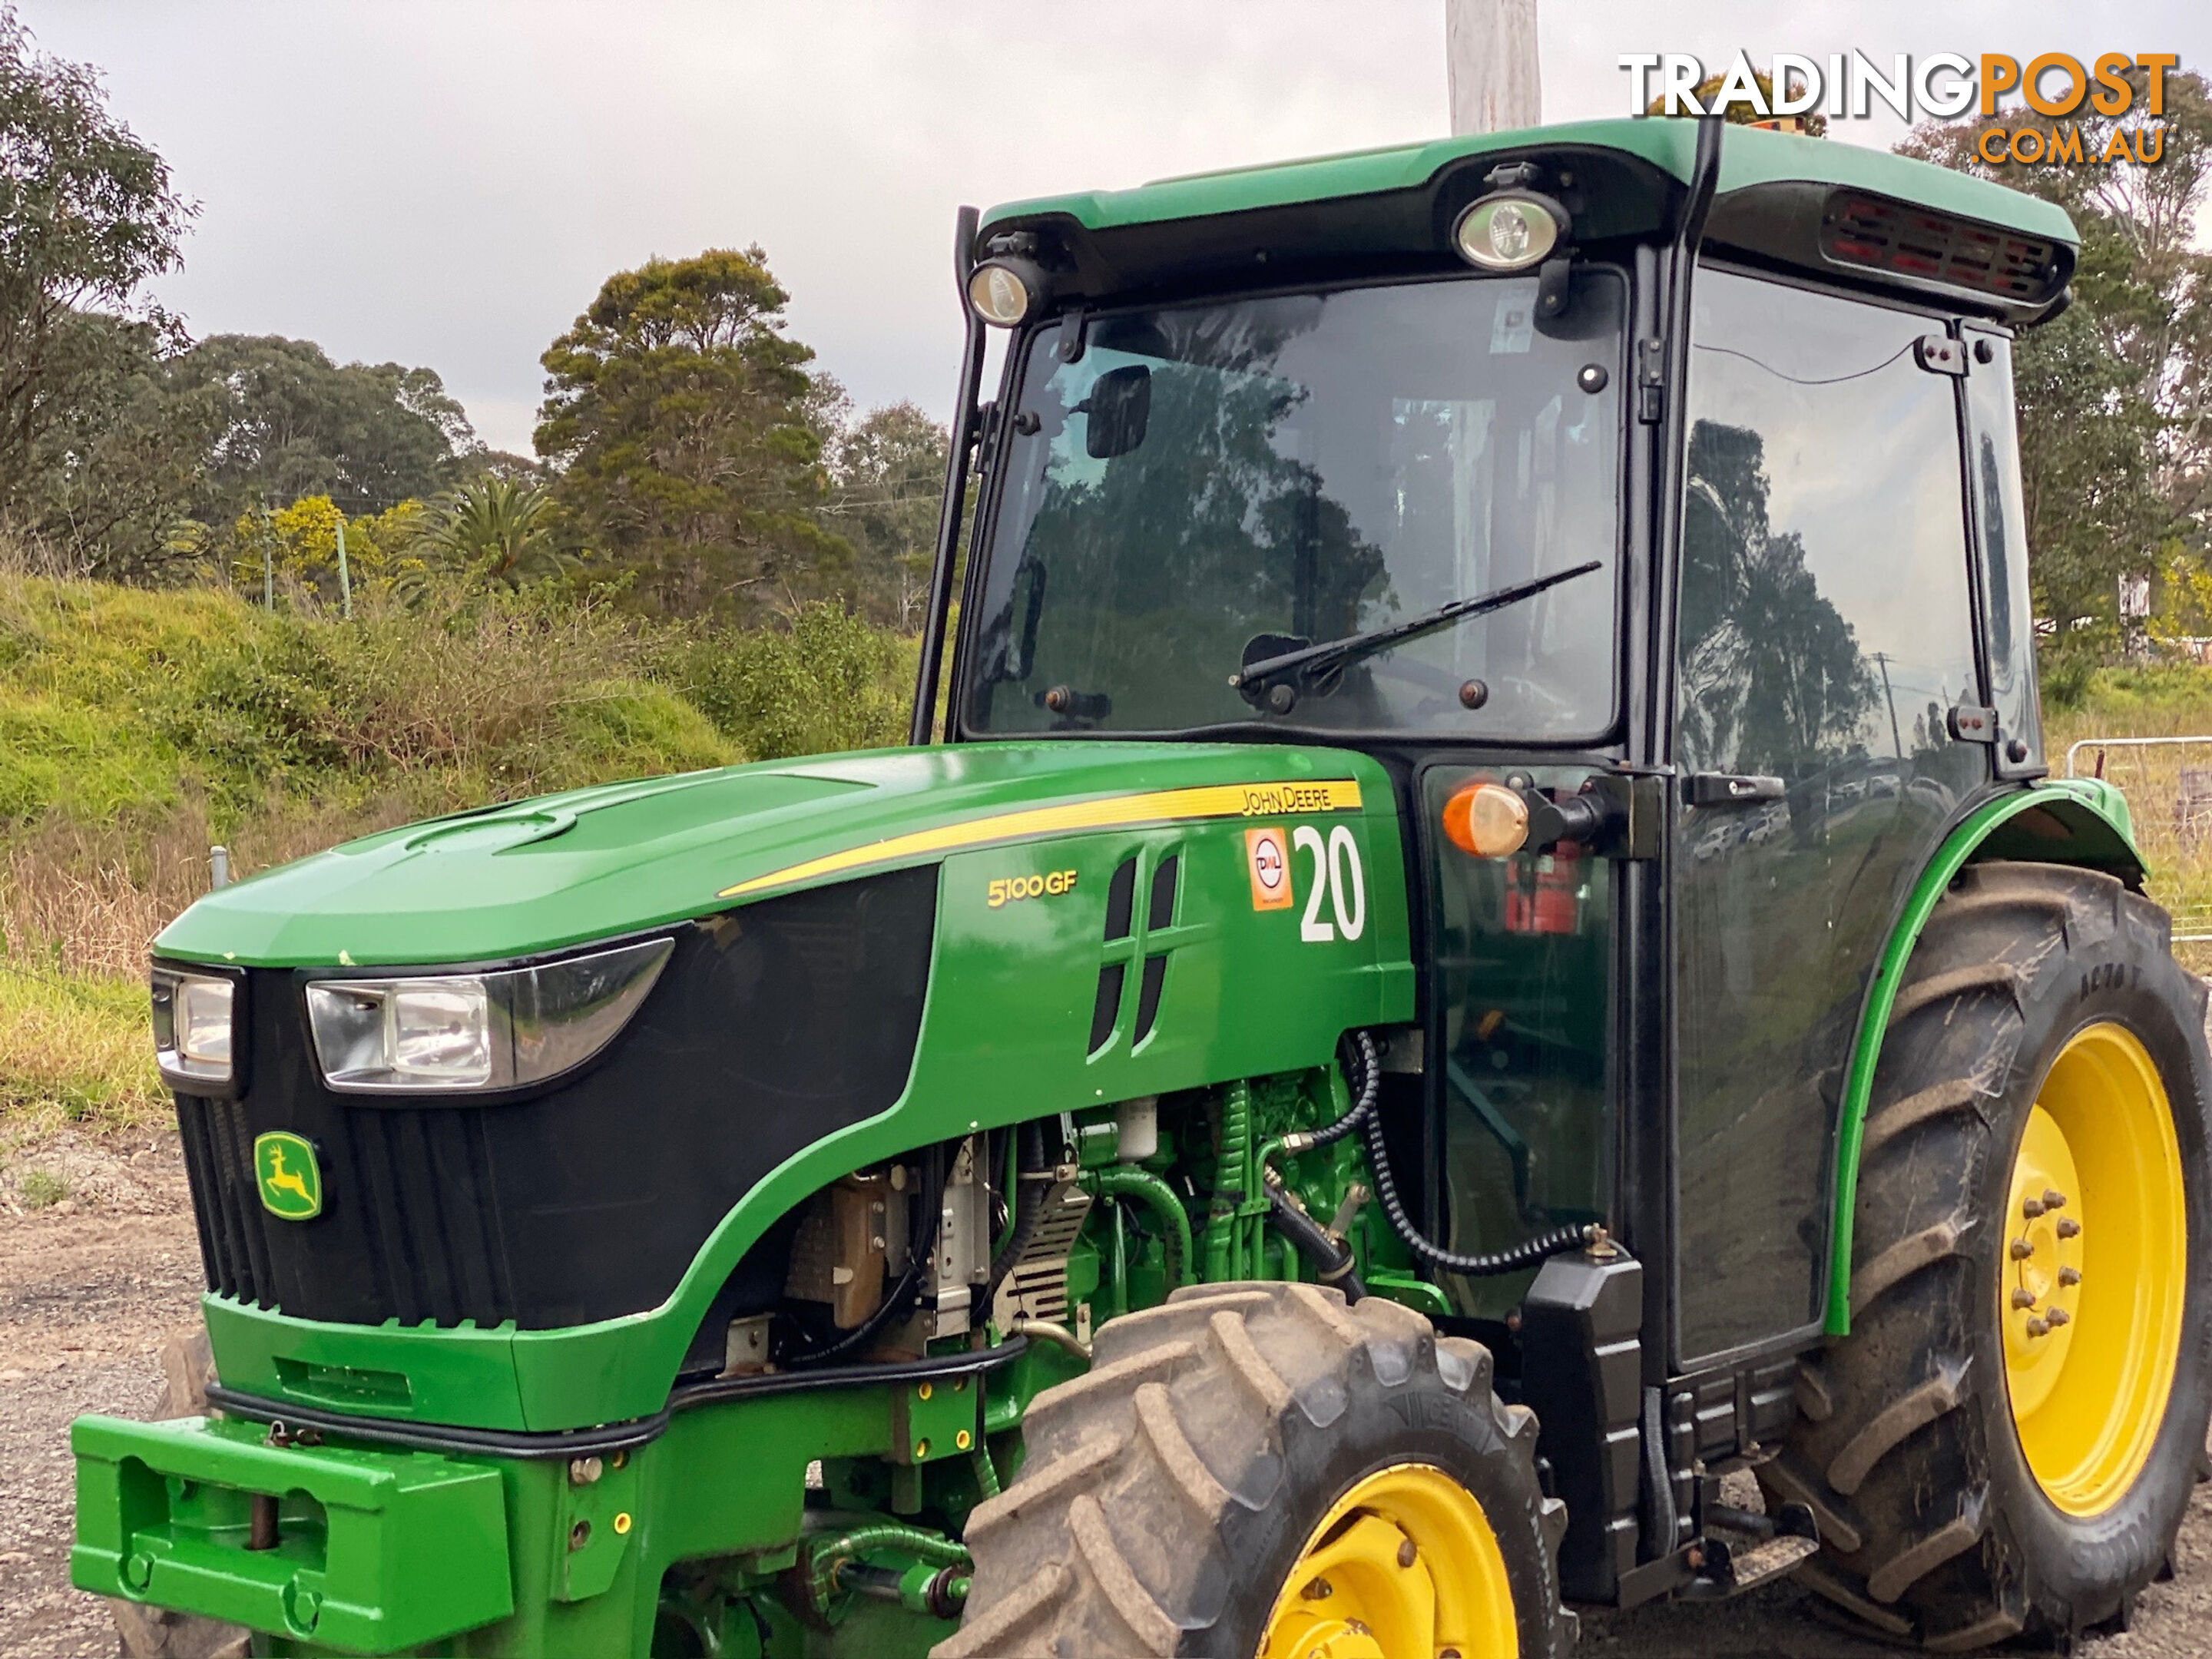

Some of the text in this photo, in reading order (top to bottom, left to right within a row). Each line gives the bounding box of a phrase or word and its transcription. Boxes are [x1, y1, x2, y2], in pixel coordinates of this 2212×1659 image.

[1243, 786, 1331, 812] JOHN DEERE
[1293, 825, 1365, 942] 20
